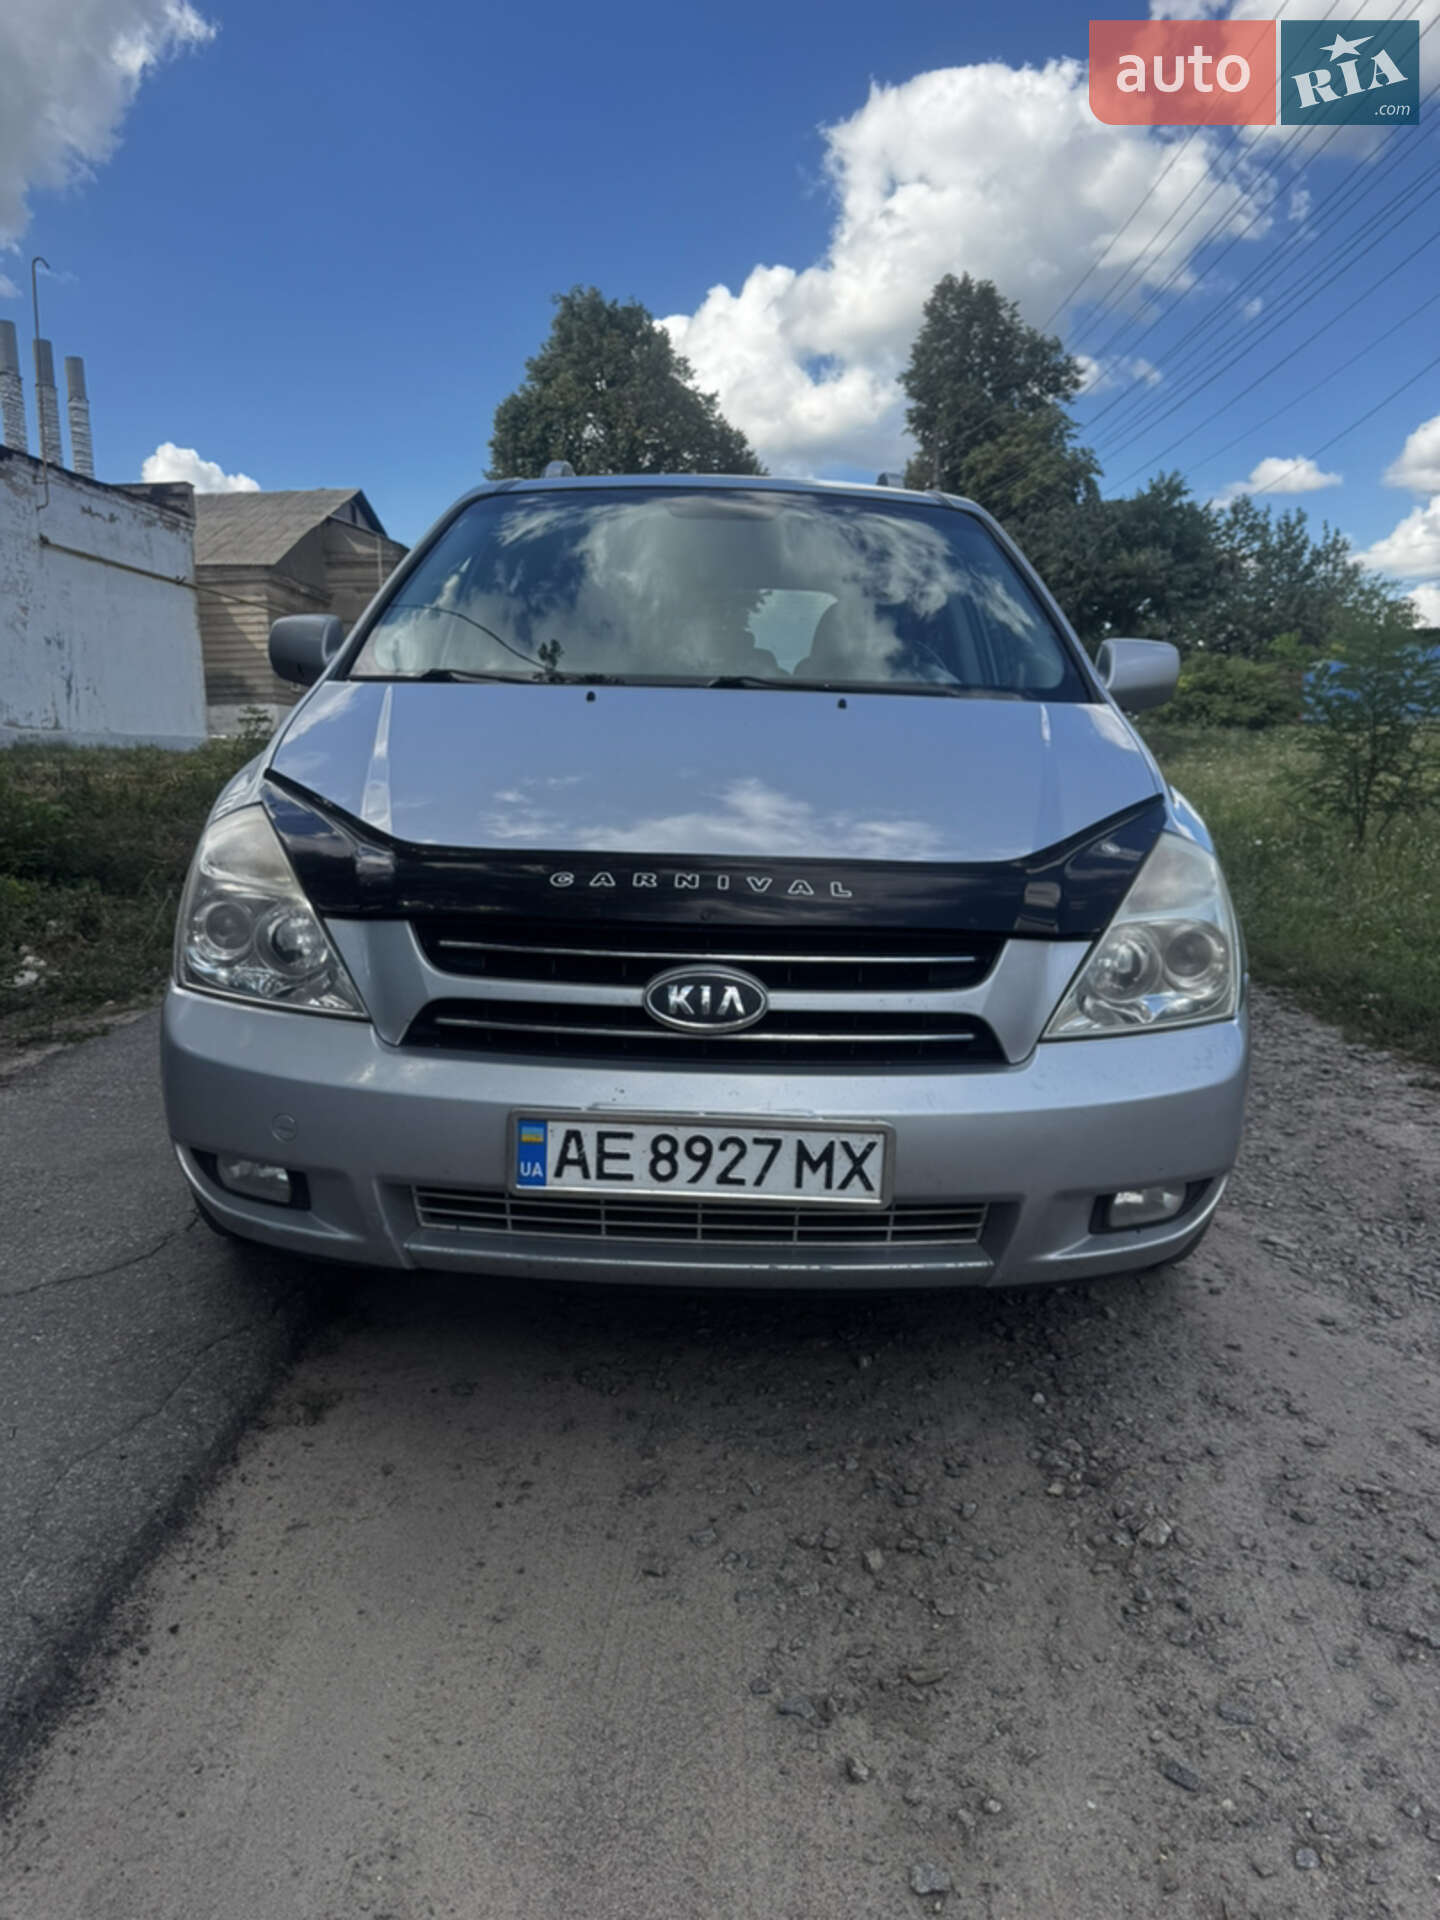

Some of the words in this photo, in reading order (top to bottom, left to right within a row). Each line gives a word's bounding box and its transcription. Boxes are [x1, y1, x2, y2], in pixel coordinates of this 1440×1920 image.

[549, 872, 852, 897] CARNIVAL
[667, 984, 746, 1016] KIA
[519, 1161, 544, 1178] UA
[553, 1129, 634, 1182] AE
[648, 1133, 783, 1187] 8927
[794, 1138, 878, 1192] MX
